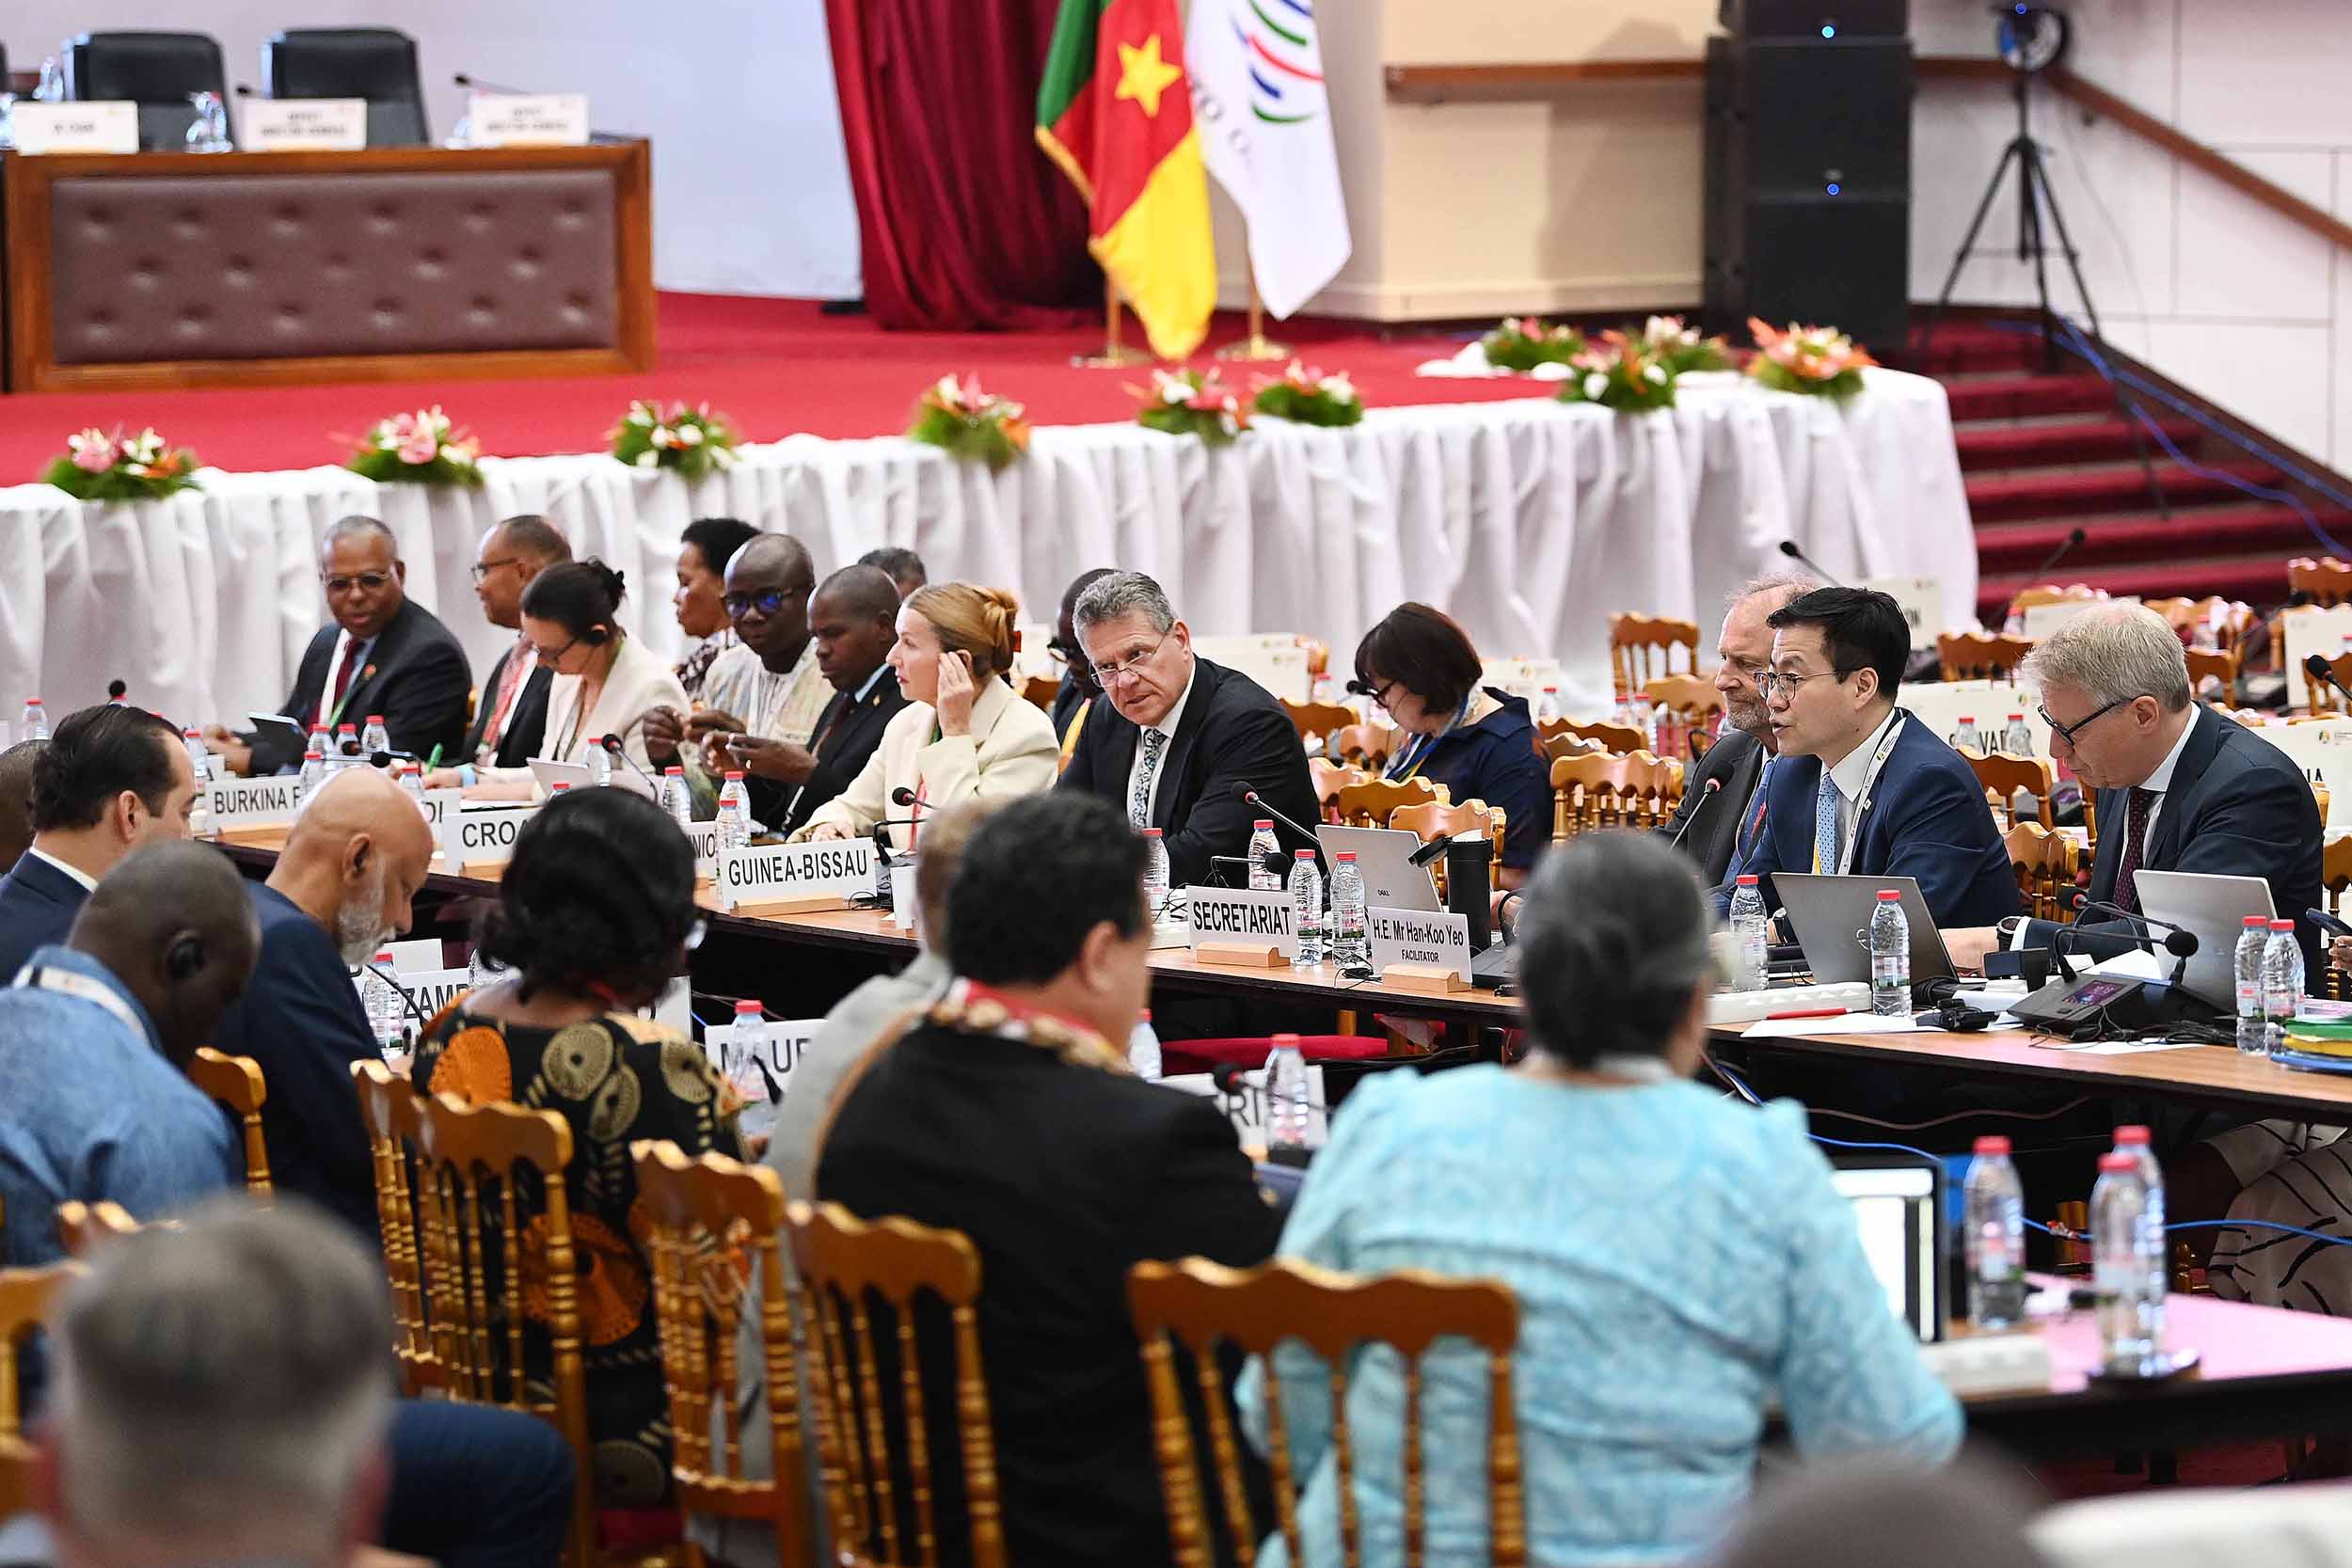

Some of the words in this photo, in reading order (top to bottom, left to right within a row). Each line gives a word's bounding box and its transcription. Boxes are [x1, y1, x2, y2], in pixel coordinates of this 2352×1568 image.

[215, 787, 288, 815] BURKINA
[462, 817, 528, 847] CRO
[688, 833, 716, 858] NIO
[728, 849, 867, 886] GUINEA-BISSAU
[1193, 900, 1290, 935] SECRETARIAT
[1373, 919, 1391, 940] H.E.
[1392, 920, 1405, 942] Mr
[1406, 921, 1444, 944] Han-Koo
[1446, 925, 1464, 946] Yeo
[1401, 949, 1439, 963] FACILITATOR
